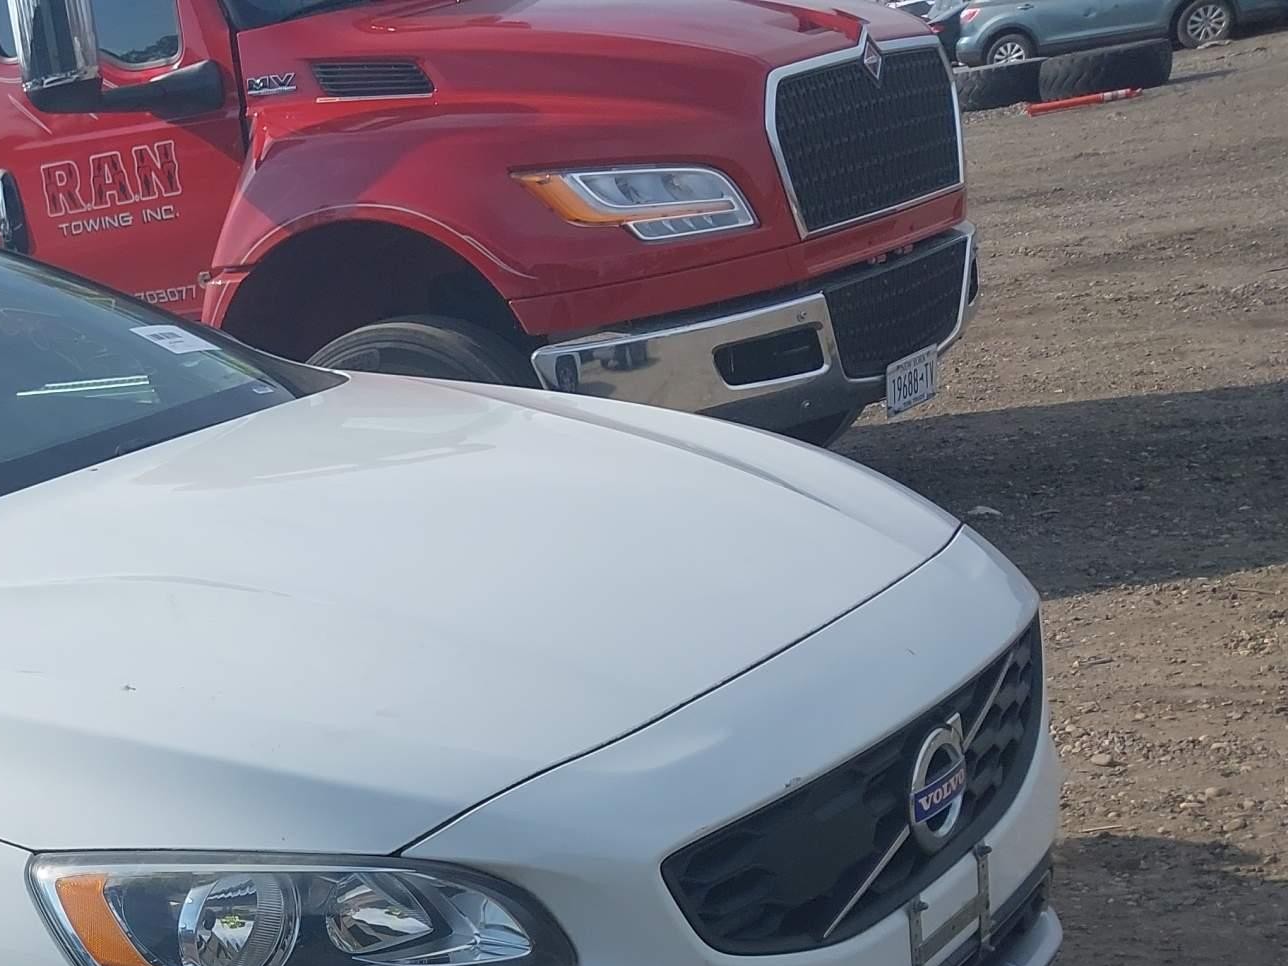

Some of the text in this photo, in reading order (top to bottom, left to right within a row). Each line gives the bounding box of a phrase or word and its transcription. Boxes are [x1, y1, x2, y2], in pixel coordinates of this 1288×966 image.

[247, 72, 296, 94] MV
[58, 204, 180, 237] TOWING INC.
[918, 768, 966, 812] VOLVO
